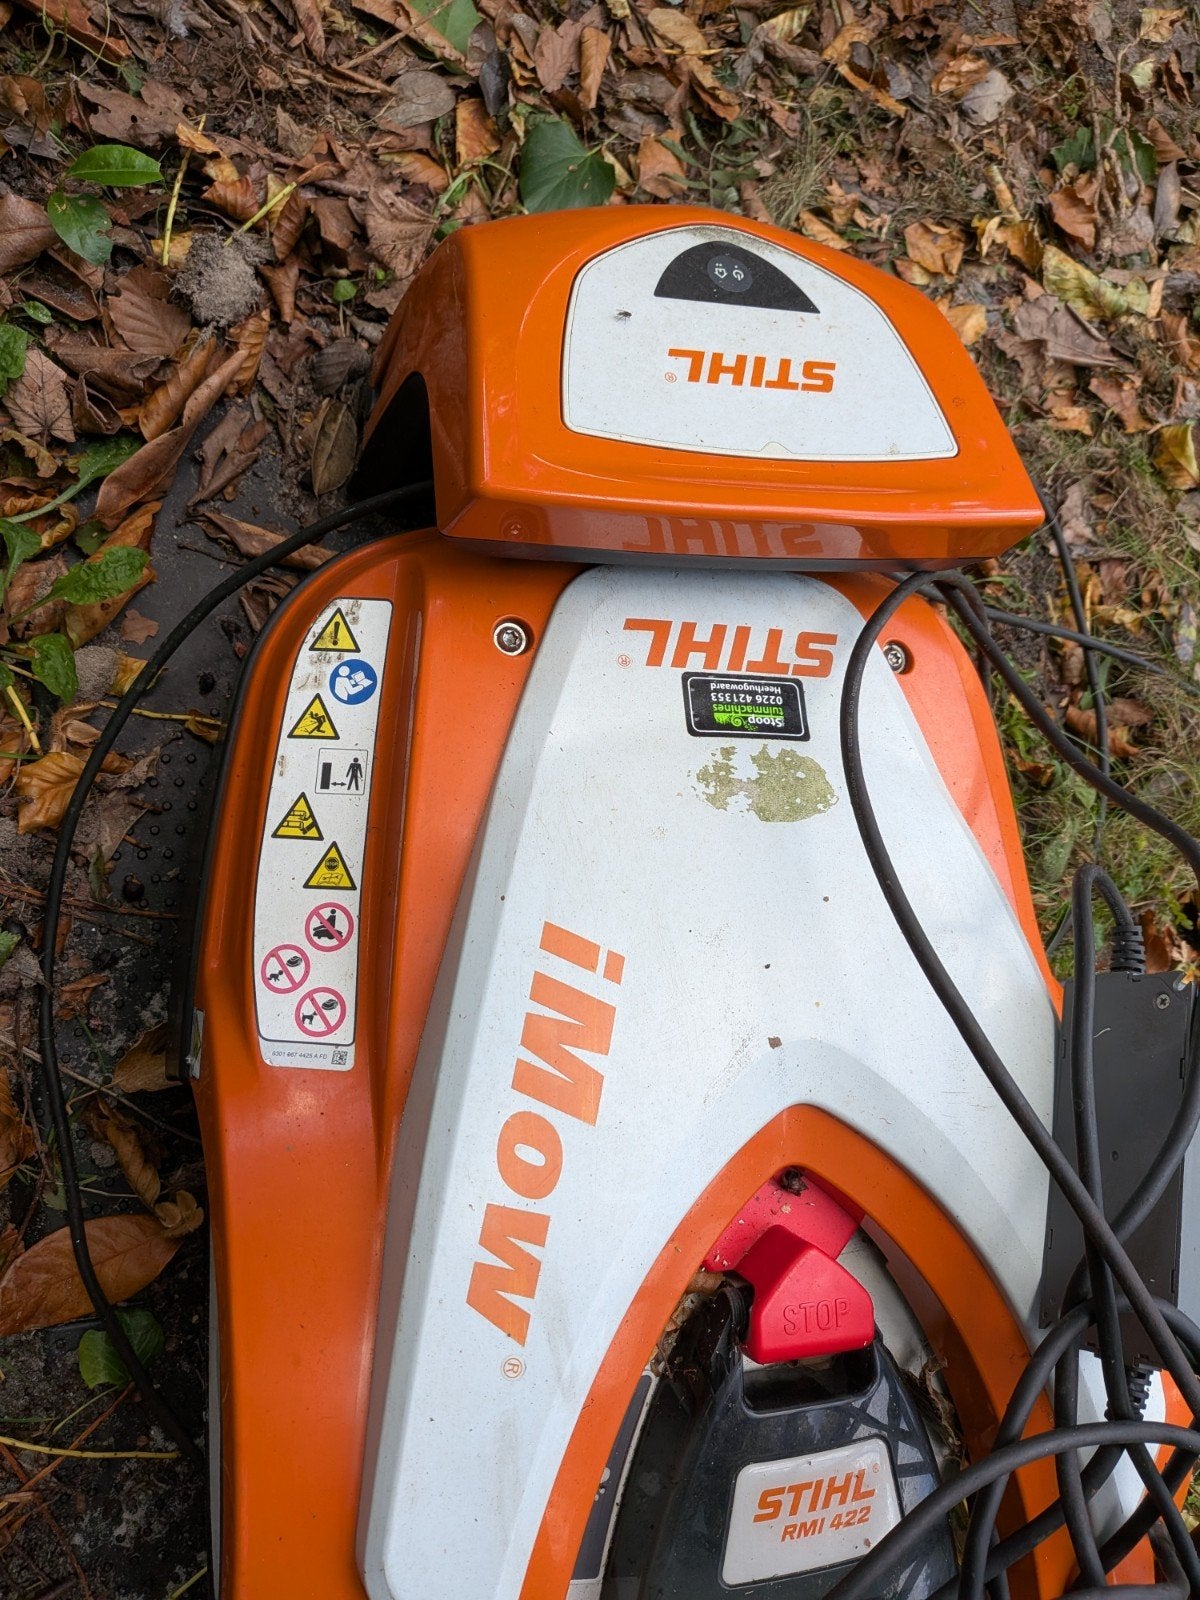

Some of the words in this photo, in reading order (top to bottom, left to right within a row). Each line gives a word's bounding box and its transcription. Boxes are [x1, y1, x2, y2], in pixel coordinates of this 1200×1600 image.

[667, 348, 836, 393] STIHL
[622, 618, 838, 679] STIHL
[710, 682, 781, 694] Heerhugowaard
[711, 692, 754, 703] 421353
[755, 694, 783, 705] 0226
[712, 703, 784, 715] tuinmachines
[748, 715, 784, 728] Stoop
[783, 1298, 850, 1336] STOP
[753, 1468, 876, 1523] STIHL
[781, 1517, 825, 1542] RMI
[829, 1505, 872, 1531] 422
